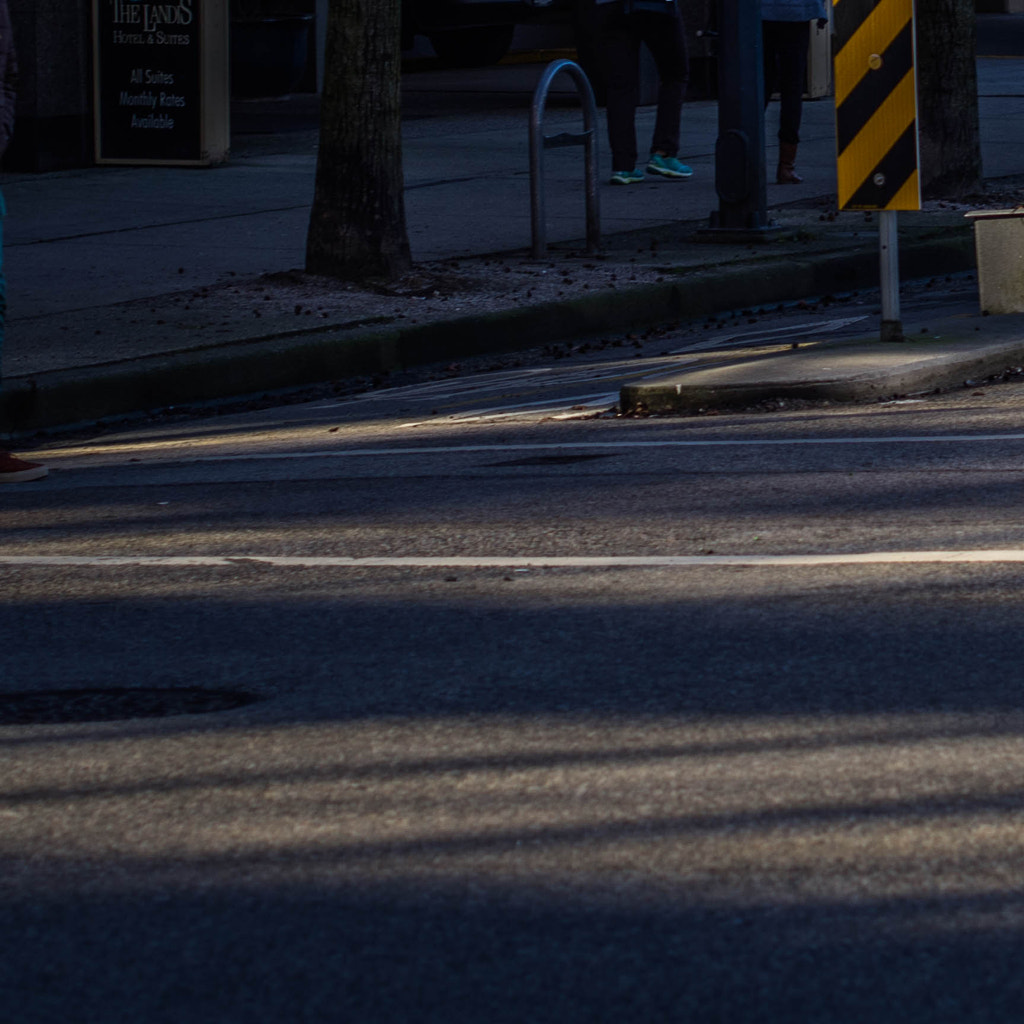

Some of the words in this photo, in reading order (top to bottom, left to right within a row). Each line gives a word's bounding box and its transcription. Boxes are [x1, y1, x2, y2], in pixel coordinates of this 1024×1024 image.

[113, 30, 145, 44] HOTEL
[146, 34, 155, 44] &
[156, 30, 190, 45] SUITES
[130, 68, 143, 85] All
[144, 68, 175, 85] Suites
[119, 90, 157, 109] Monthly
[159, 91, 186, 107] Rates
[131, 113, 175, 129] Available
